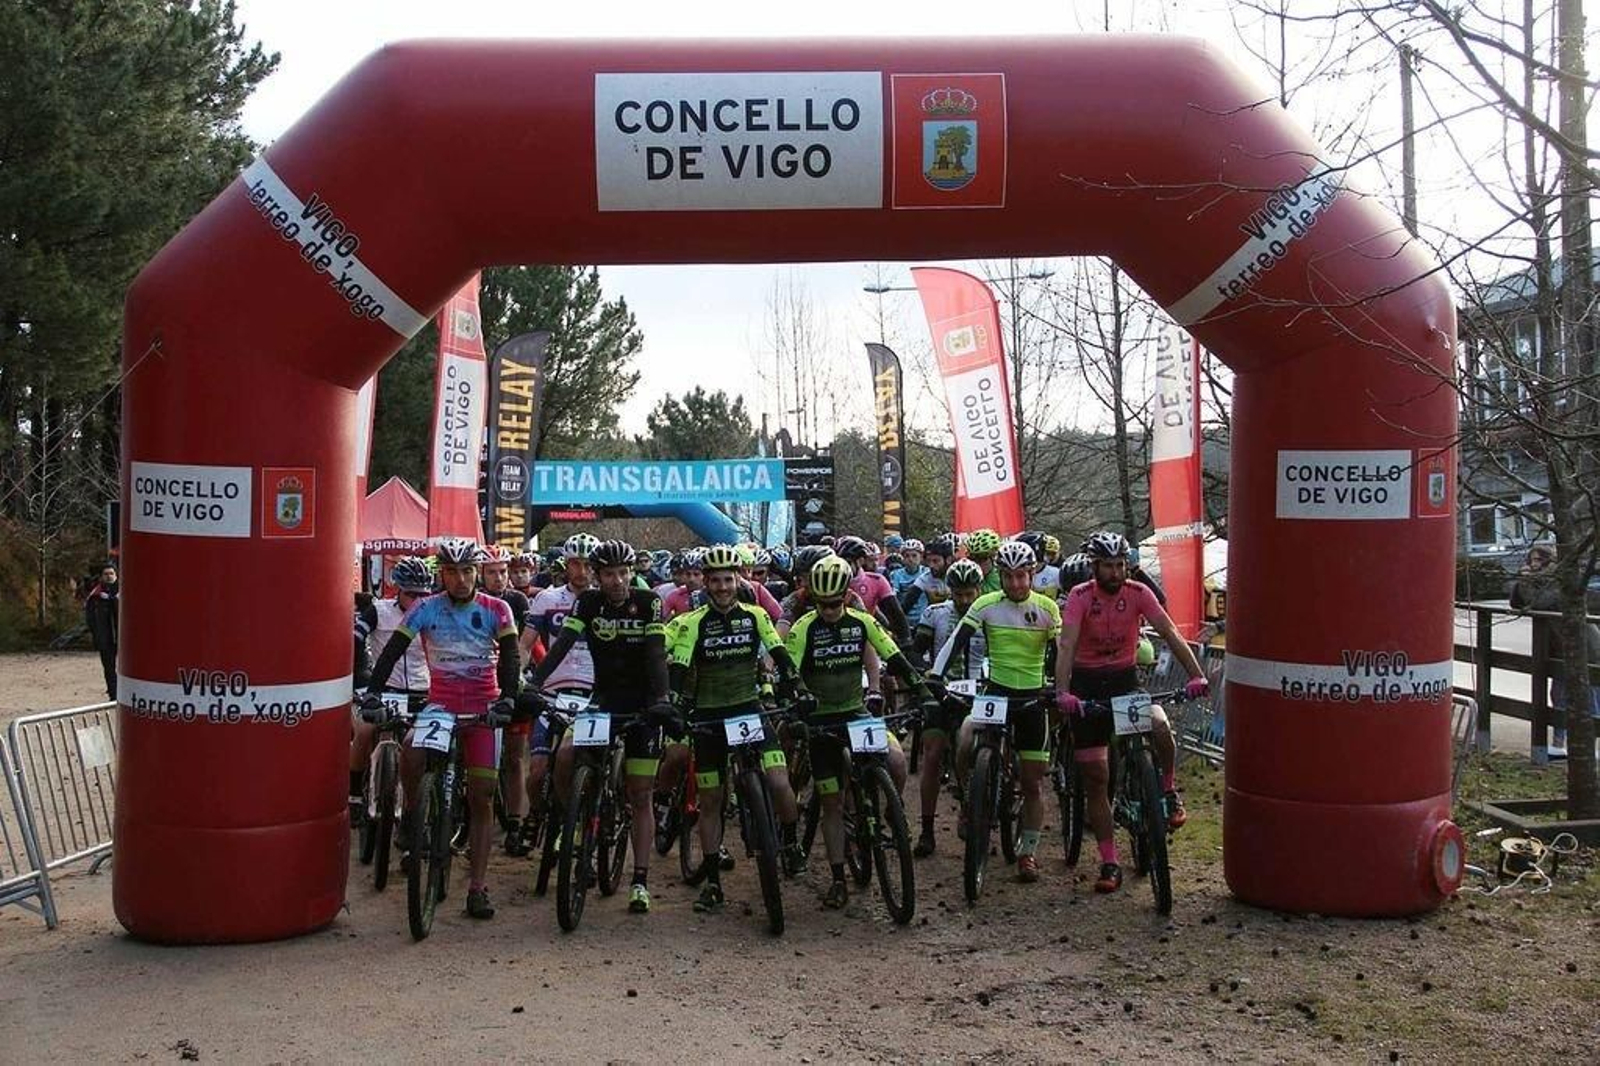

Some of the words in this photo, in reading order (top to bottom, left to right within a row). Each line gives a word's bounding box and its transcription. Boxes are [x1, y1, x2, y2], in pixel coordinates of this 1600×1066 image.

[614, 98, 860, 134] CONCELLO
[646, 145, 704, 180] DE
[721, 143, 832, 179] VIGO
[249, 180, 301, 243] terreo
[300, 240, 333, 274] de
[330, 272, 385, 320] xogo
[1217, 239, 1288, 301] terreo
[1287, 208, 1317, 239] de
[455, 380, 471, 429] VIGO
[498, 358, 536, 451] RELAY
[443, 364, 457, 476] CONCELLO
[452, 437, 468, 465] DE
[502, 464, 521, 476] TEAM
[534, 464, 772, 493] TRANSGALAICA
[1285, 465, 1401, 482] CONCELLO
[135, 477, 240, 499] CONCELLO
[501, 481, 521, 492] RELAY
[1298, 487, 1325, 504] DE
[1334, 487, 1388, 504] VIGO
[143, 500, 165, 518] DE
[172, 502, 224, 521] VIGO
[703, 633, 754, 647] EXTOL
[813, 643, 862, 657] EXTOL
[1280, 675, 1361, 701] terreo
[1372, 678, 1402, 704] de
[130, 692, 197, 722] terreo
[208, 699, 241, 724] de
[251, 699, 313, 727] xogo
[984, 701, 996, 718] 9
[424, 720, 441, 741] 2
[588, 720, 596, 738] 7
[738, 721, 751, 738] 3
[863, 726, 874, 745] 1
